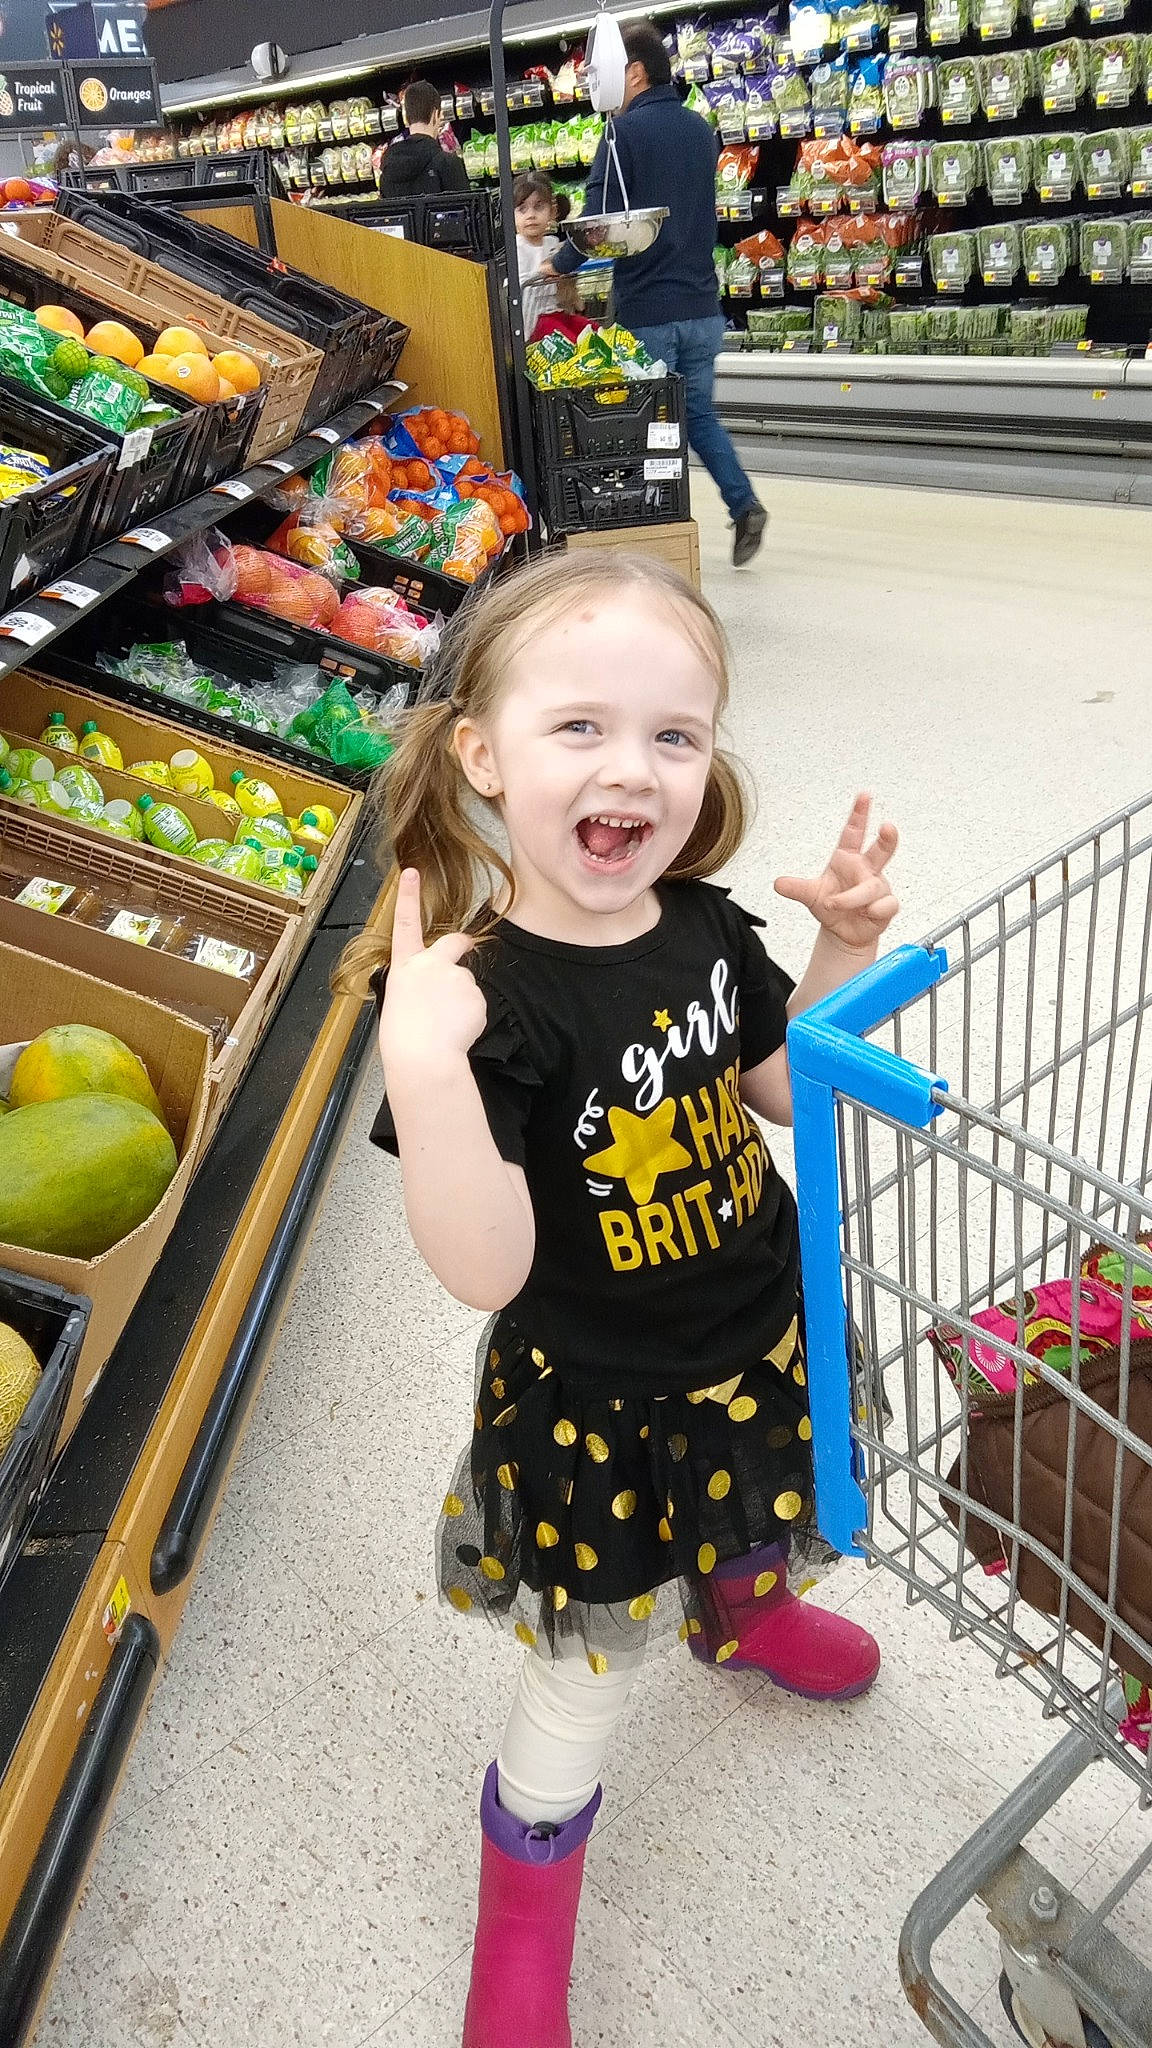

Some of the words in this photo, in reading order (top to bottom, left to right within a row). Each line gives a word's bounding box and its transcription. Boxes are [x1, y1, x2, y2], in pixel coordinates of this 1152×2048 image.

[14, 80, 55, 97] Tropical
[110, 87, 151, 104] Oranges
[17, 98, 43, 111] Fruit
[621, 958, 738, 1112] girl
[599, 1180, 720, 1271] BRIT
